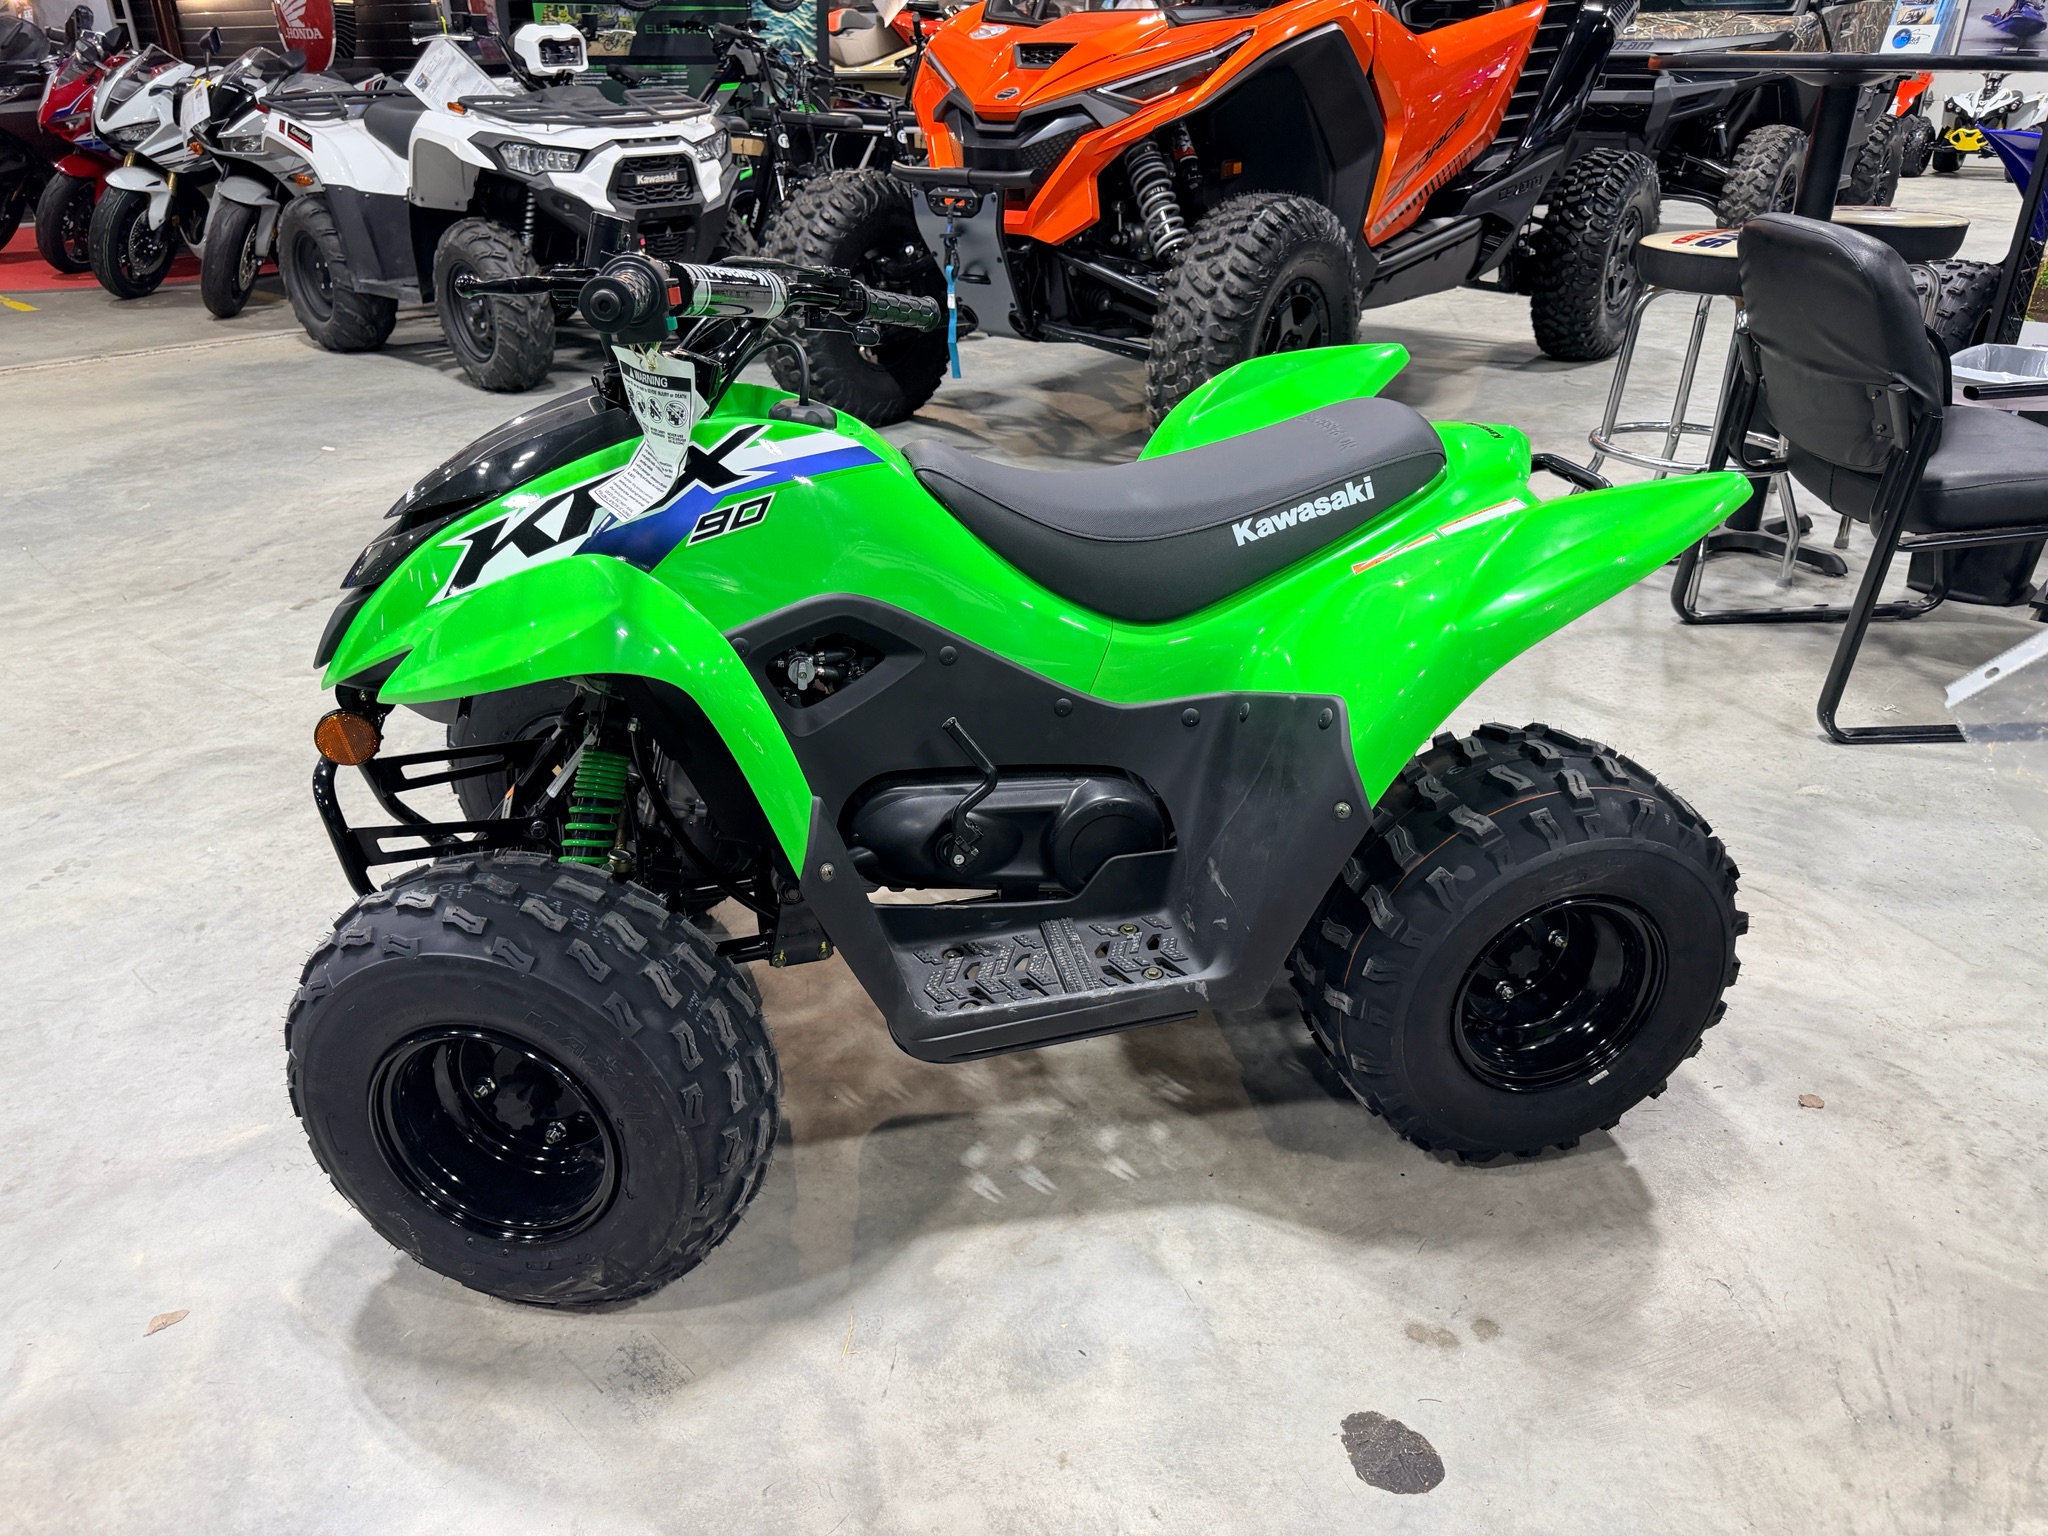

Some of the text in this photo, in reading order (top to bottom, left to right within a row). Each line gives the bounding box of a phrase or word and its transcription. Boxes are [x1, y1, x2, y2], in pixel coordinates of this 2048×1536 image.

[286, 27, 324, 39] HONDA
[1612, 41, 1655, 51] n-am
[636, 171, 678, 185] Kawasaki
[633, 369, 669, 388] WARNING
[1231, 475, 1376, 547] Kawasaki
[690, 495, 773, 545] 90
